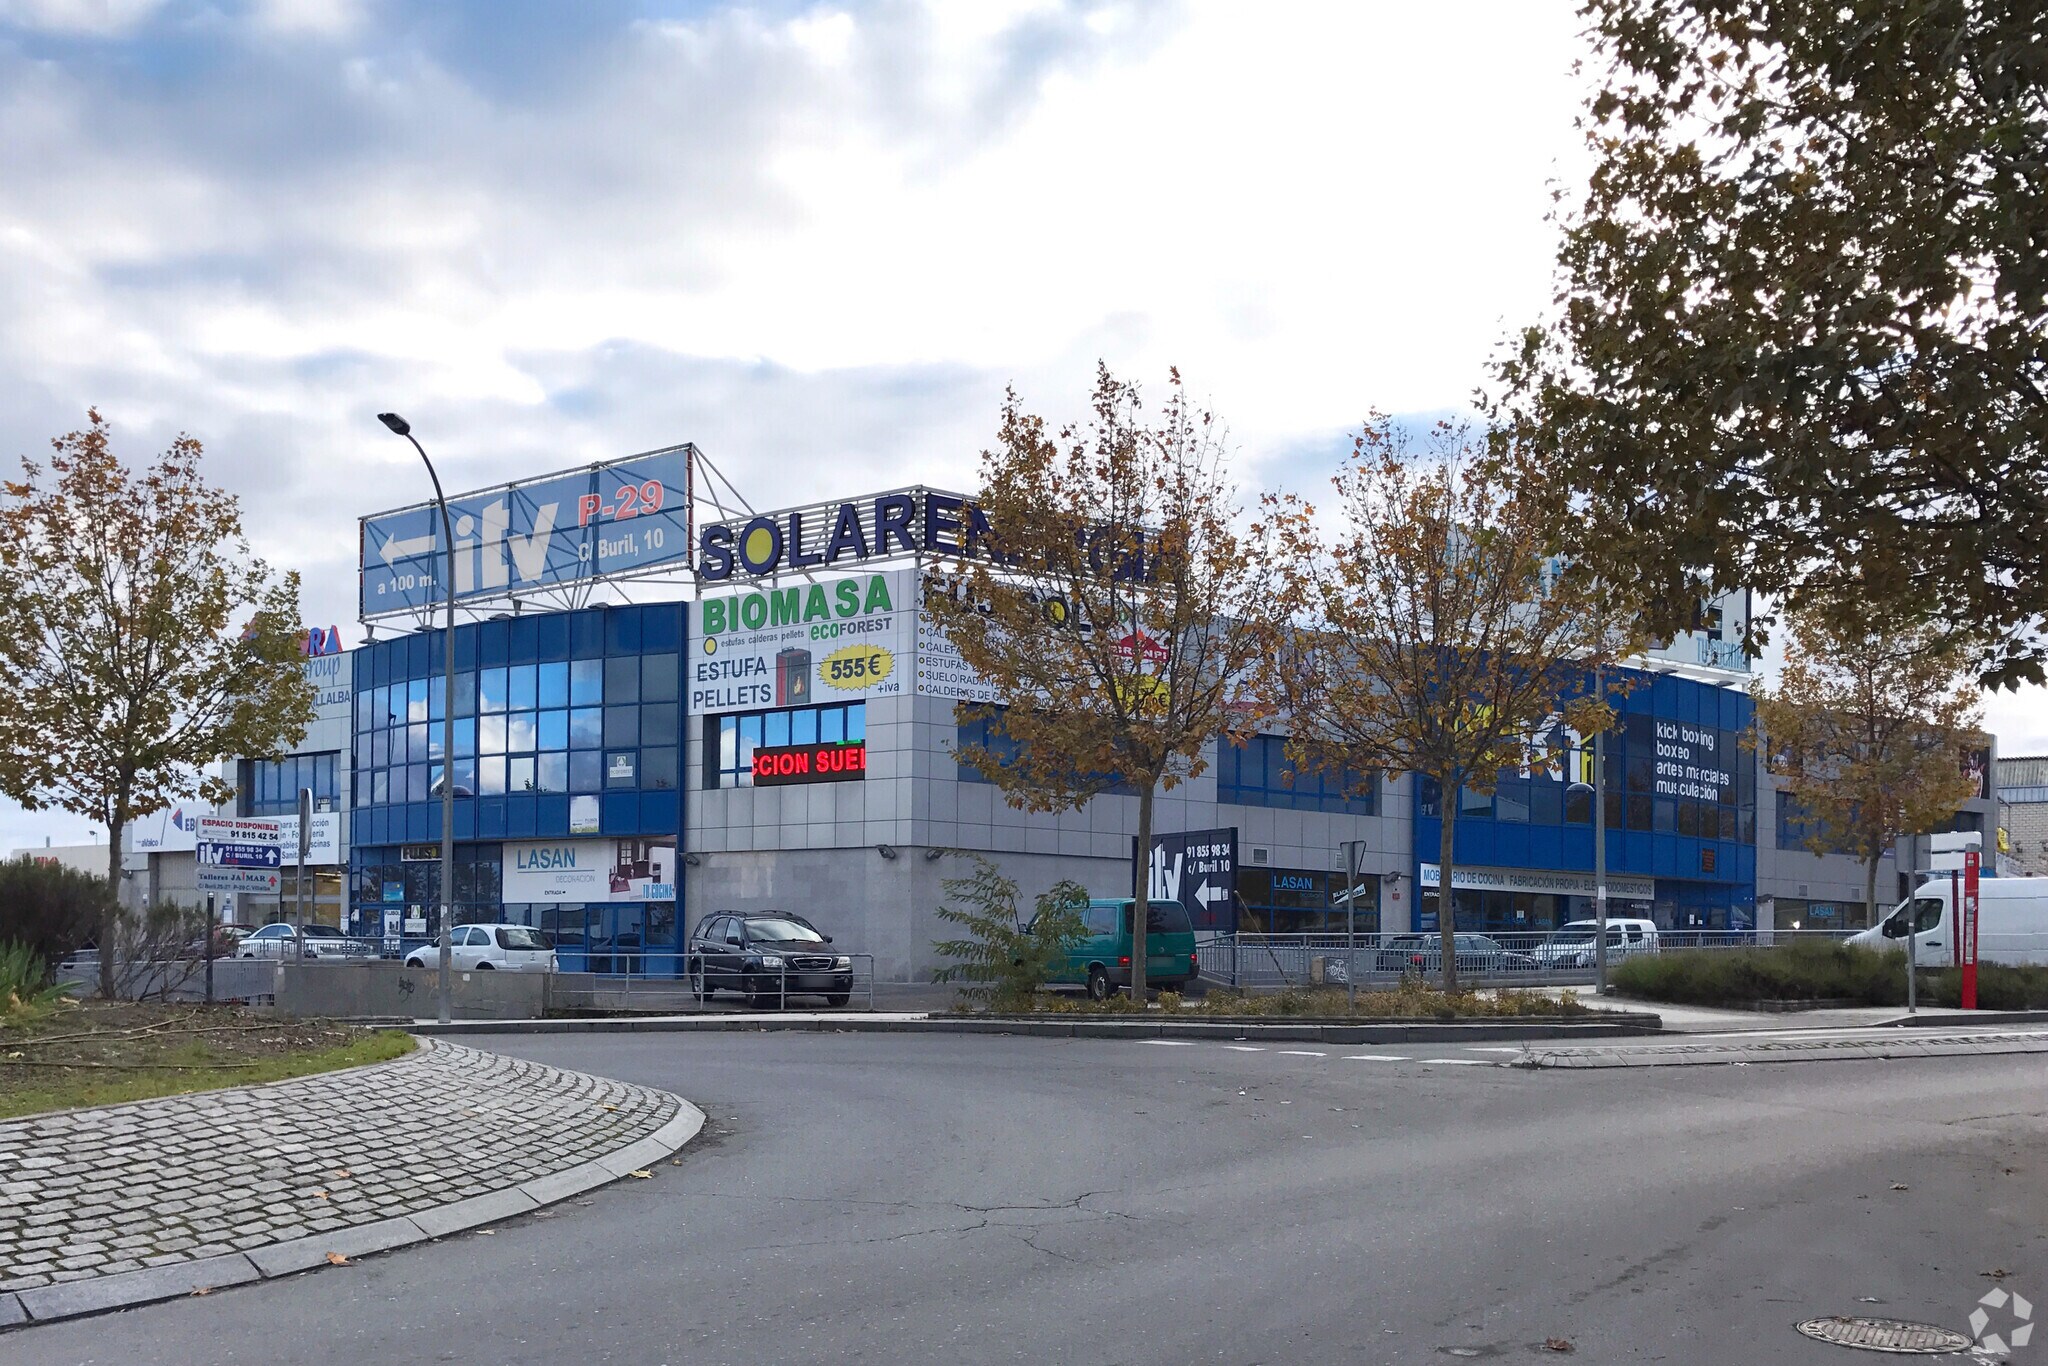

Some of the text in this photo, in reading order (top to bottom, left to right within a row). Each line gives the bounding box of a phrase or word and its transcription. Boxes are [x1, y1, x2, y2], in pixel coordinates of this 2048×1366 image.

[577, 479, 665, 529] P-29
[455, 498, 559, 594] itv
[643, 527, 665, 550] 10
[377, 582, 387, 595] a
[389, 575, 416, 593] 100
[702, 574, 894, 636] BIOMASA
[720, 628, 805, 649] estufas calderas pellets
[926, 642, 961, 655] CALEFA
[305, 656, 340, 687] roup
[696, 656, 768, 683] ESTUFA
[926, 656, 969, 672] ESTUFAS
[926, 671, 958, 684] SUELO
[693, 683, 772, 710] PELLETS
[877, 681, 900, 694] +iva
[925, 685, 976, 700] CALDERAS
[977, 690, 991, 700] DE
[1656, 722, 1714, 751] kick boxing
[1656, 741, 1690, 760] boxeo
[1656, 761, 1730, 786] artes marciales
[1656, 780, 1718, 801] musculación
[202, 819, 279, 832] ESPACIO DISPONIBLE
[230, 830, 240, 838] 91
[241, 831, 256, 839] 815
[257, 832, 267, 840] 42
[269, 833, 279, 841] 54
[200, 844, 224, 864] itv
[517, 848, 575, 869] LASAN
[1186, 843, 1230, 859] 91 855 98 34
[1198, 859, 1218, 873] Buril
[1219, 859, 1230, 872] 10
[199, 873, 229, 881] Talleres
[1273, 875, 1313, 890] LASAN
[1466, 872, 1477, 883] DE
[1477, 873, 1505, 886] COCINA
[1555, 879, 1580, 890] PROPIA
[642, 883, 652, 899] TU
